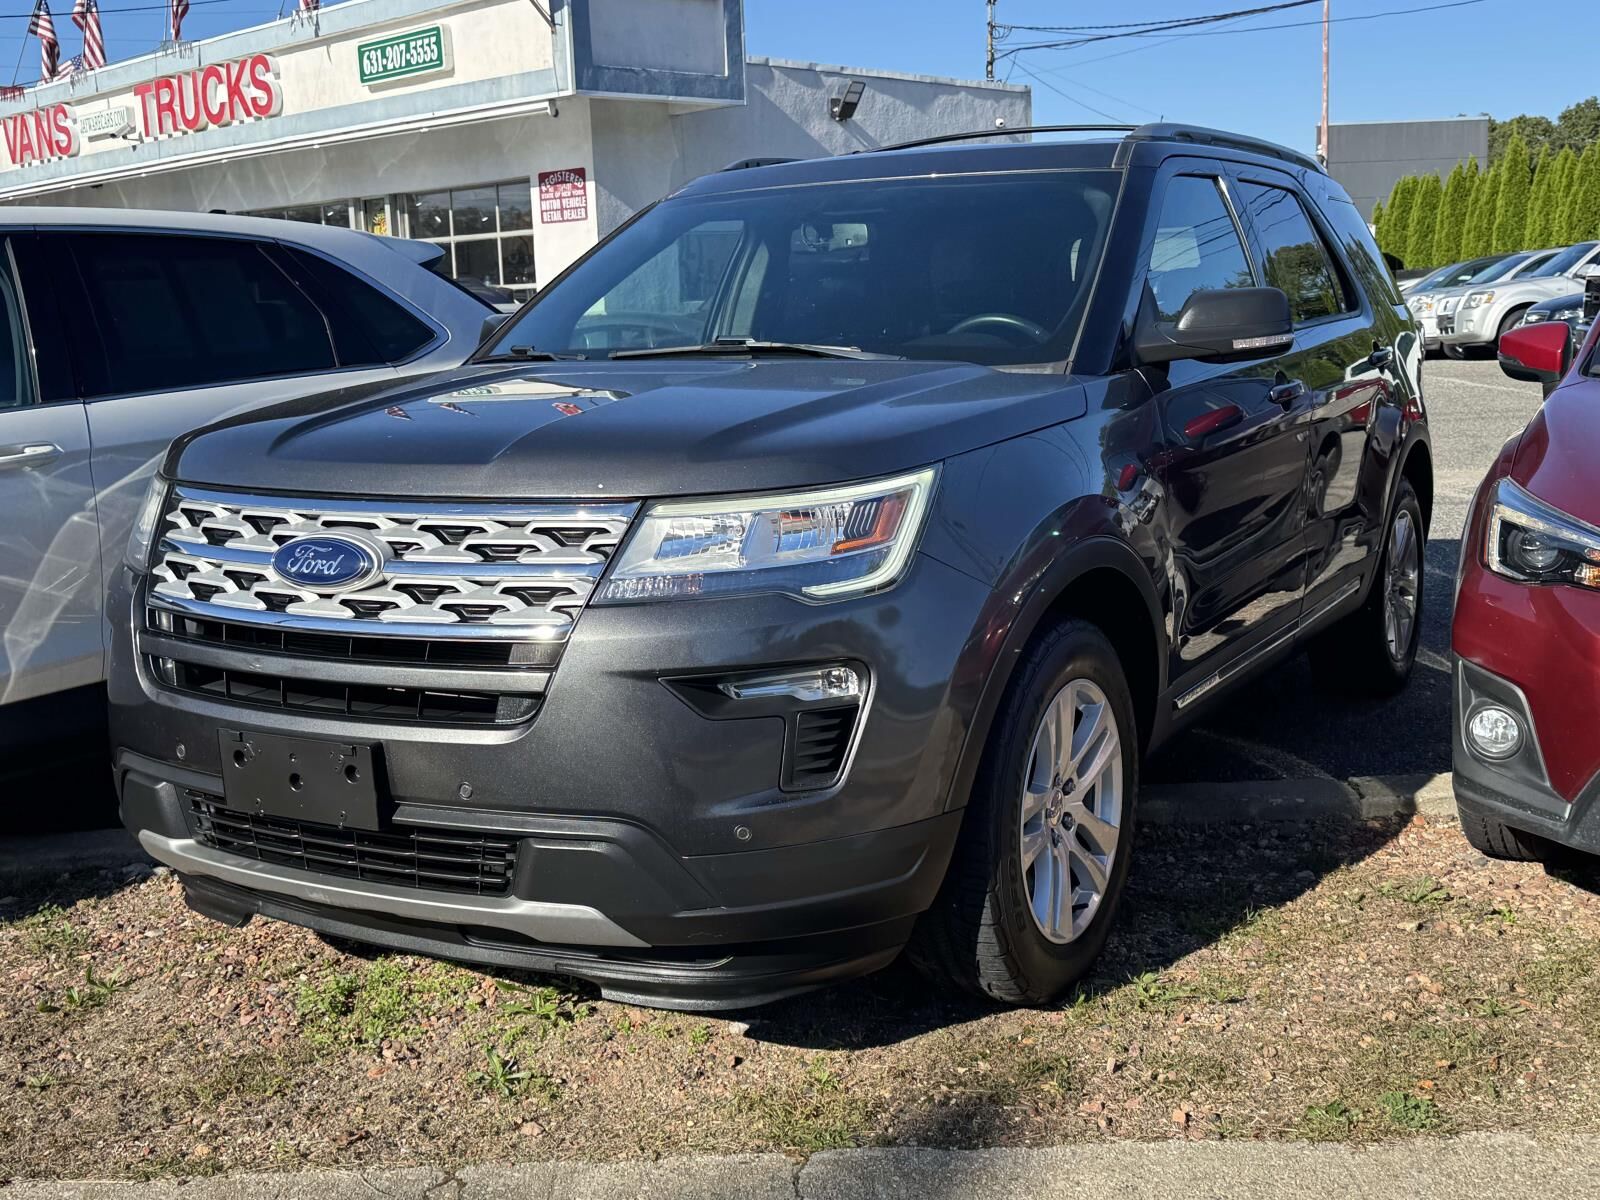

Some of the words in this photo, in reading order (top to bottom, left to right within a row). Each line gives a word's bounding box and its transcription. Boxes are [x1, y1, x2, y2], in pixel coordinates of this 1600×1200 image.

[134, 54, 273, 137] TRUCKS
[3, 103, 72, 165] VANS
[541, 171, 584, 192] REGISTERED
[541, 198, 561, 210] MOTOR
[562, 195, 586, 208] VEHICLE
[561, 190, 571, 198] NEW
[572, 189, 585, 197] YORK
[543, 210, 563, 222] RETAIL
[563, 207, 586, 220] DEALER
[287, 544, 344, 575] Ford
